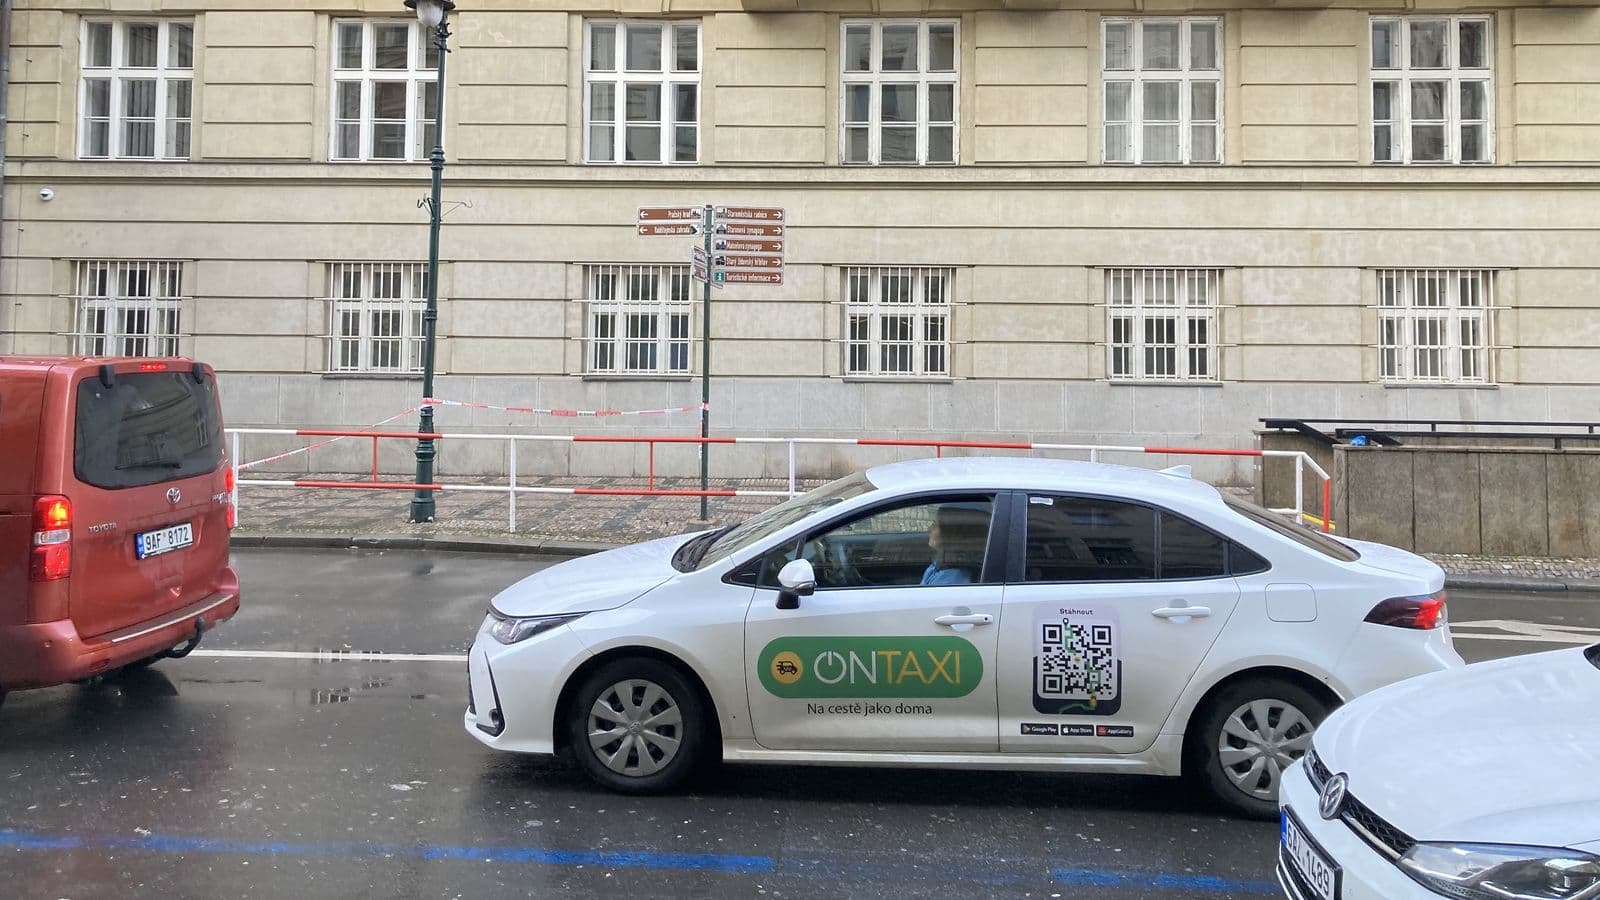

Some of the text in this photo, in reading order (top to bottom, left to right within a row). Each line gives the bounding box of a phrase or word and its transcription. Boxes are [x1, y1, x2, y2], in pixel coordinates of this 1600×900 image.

[88, 522, 117, 533] TOYOTA
[145, 526, 189, 551] 9AF 8172
[813, 650, 961, 684] ONTAXI
[807, 702, 933, 716] Na cestě jako doma
[1031, 726, 1047, 734] Google
[1305, 849, 1330, 897] 1489
